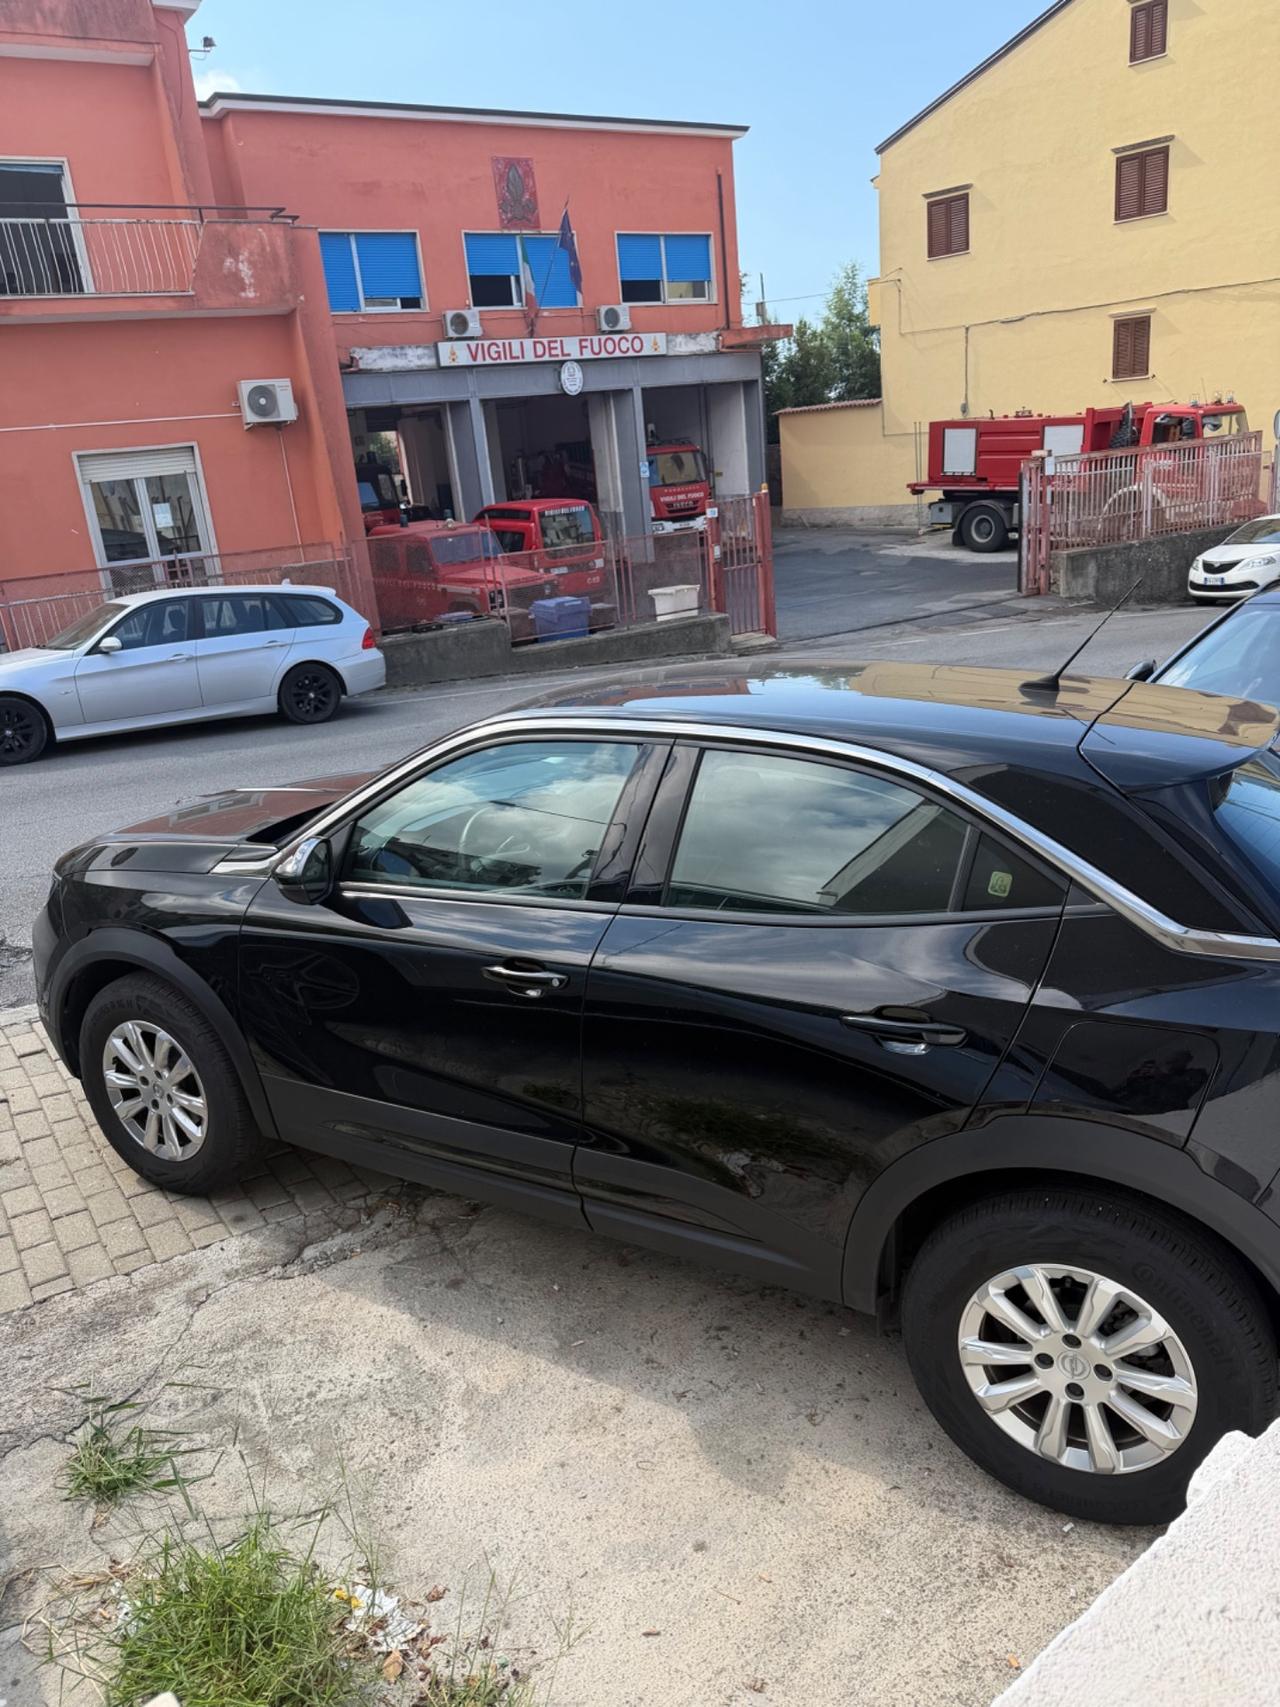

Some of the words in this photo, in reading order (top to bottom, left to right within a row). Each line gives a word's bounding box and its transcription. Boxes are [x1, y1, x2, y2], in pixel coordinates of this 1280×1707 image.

[466, 340, 525, 363] VIGILI
[533, 339, 571, 359] DEL
[578, 335, 644, 357] FUOCO
